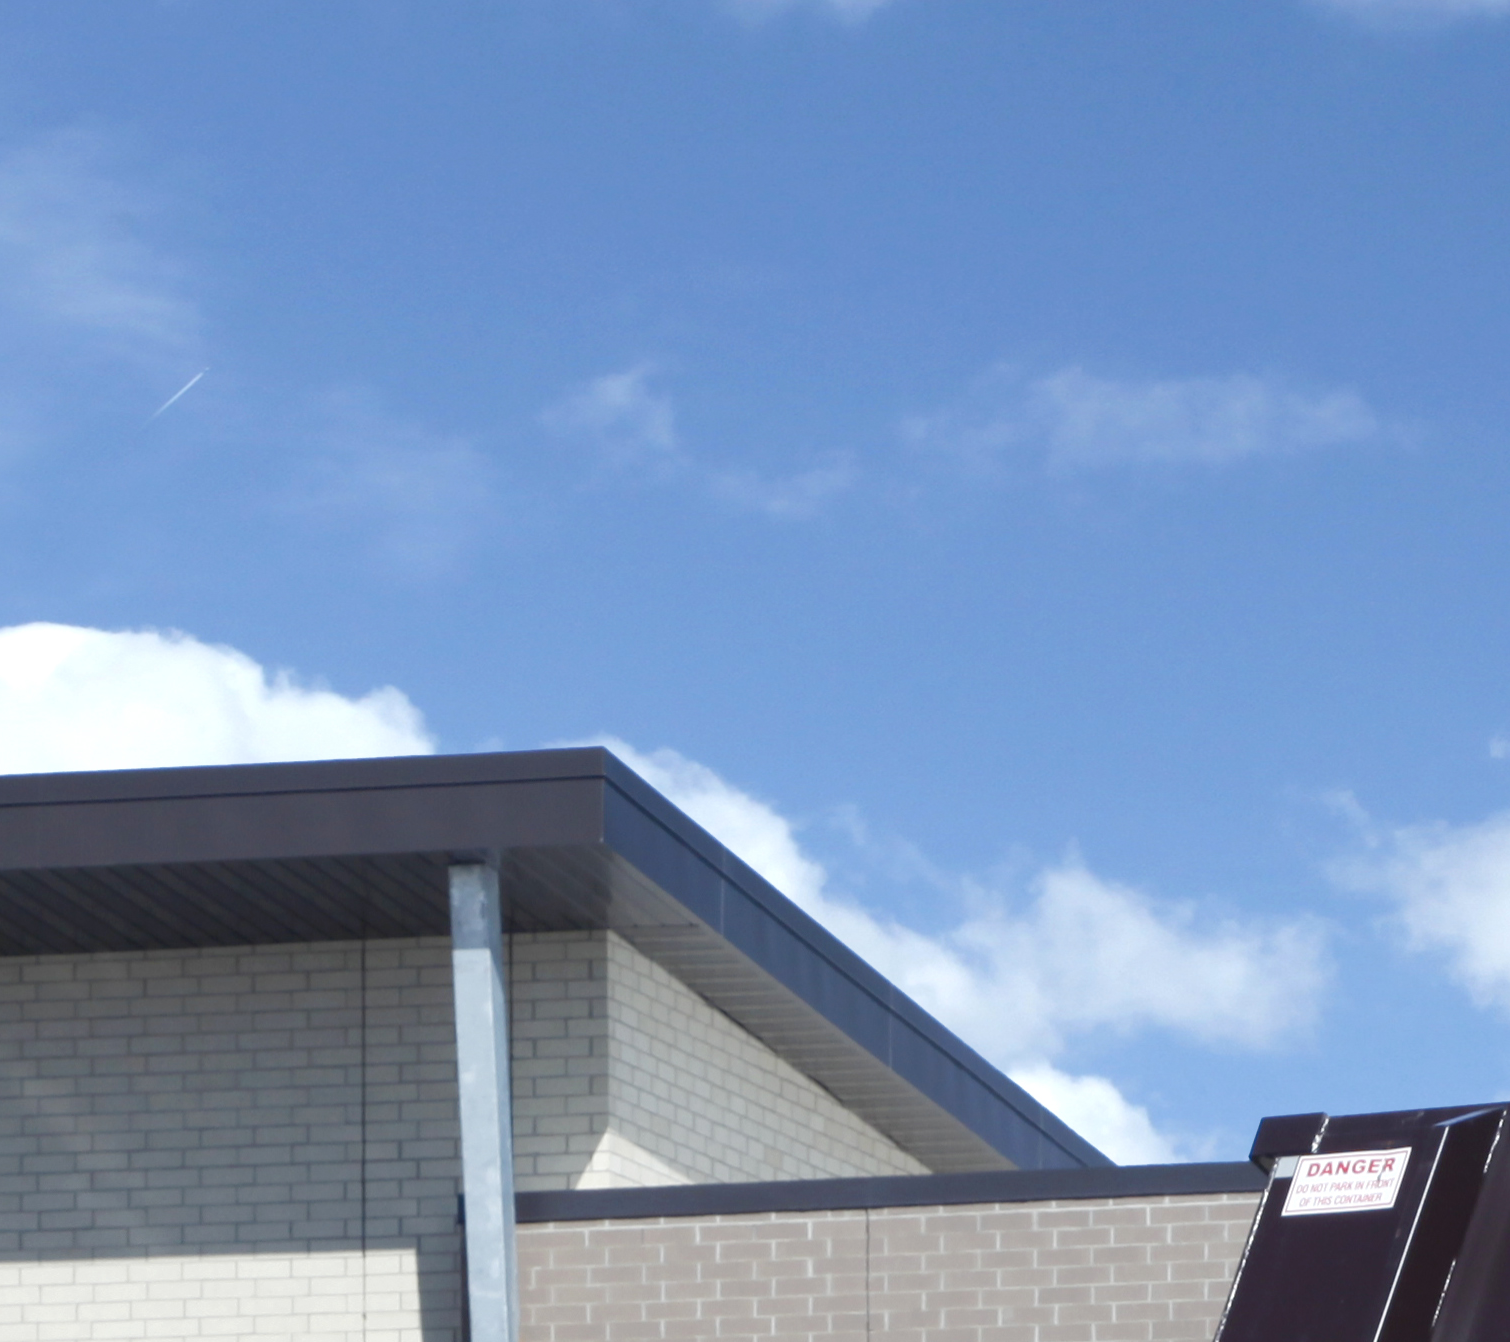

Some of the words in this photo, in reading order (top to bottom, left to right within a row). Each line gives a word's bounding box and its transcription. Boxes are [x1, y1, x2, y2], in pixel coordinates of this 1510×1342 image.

[1306, 1157, 1396, 1177] DANGER
[1295, 1184, 1309, 1194] DO
[1309, 1183, 1328, 1193] NOT
[1329, 1181, 1353, 1191] PARK
[1354, 1180, 1364, 1190] IN
[1365, 1177, 1395, 1189] FRONT
[1298, 1197, 1311, 1207] OF
[1312, 1195, 1332, 1206] THIS
[1333, 1192, 1383, 1205] CONTAINER
